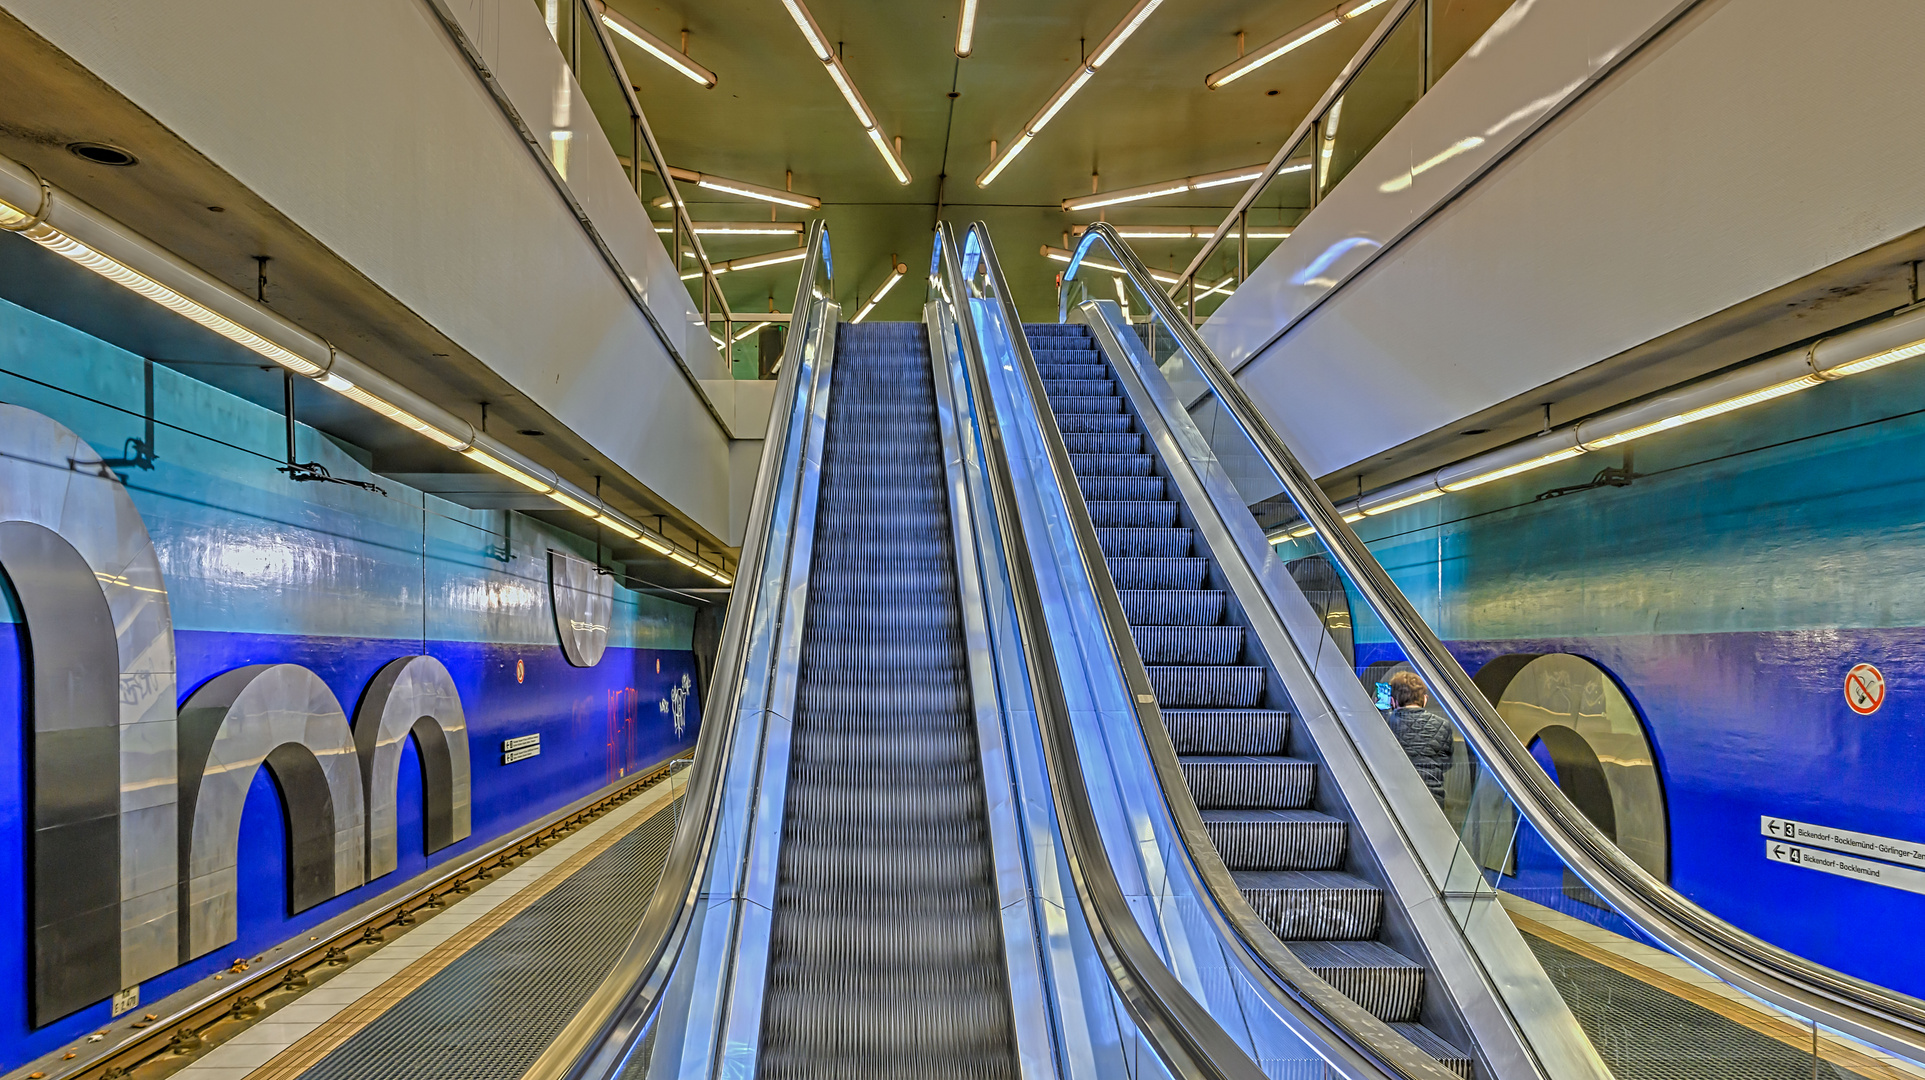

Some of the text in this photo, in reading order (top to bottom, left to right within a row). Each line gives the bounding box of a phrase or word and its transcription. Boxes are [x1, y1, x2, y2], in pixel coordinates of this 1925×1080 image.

[1786, 824, 1793, 836] 3
[1798, 829, 1830, 841] Bickendorf
[1834, 836, 1874, 850] Bocklemünd
[1791, 850, 1799, 862] 4
[1804, 854, 1835, 867] Bickendorf
[1840, 862, 1880, 877] Bocklemünd
